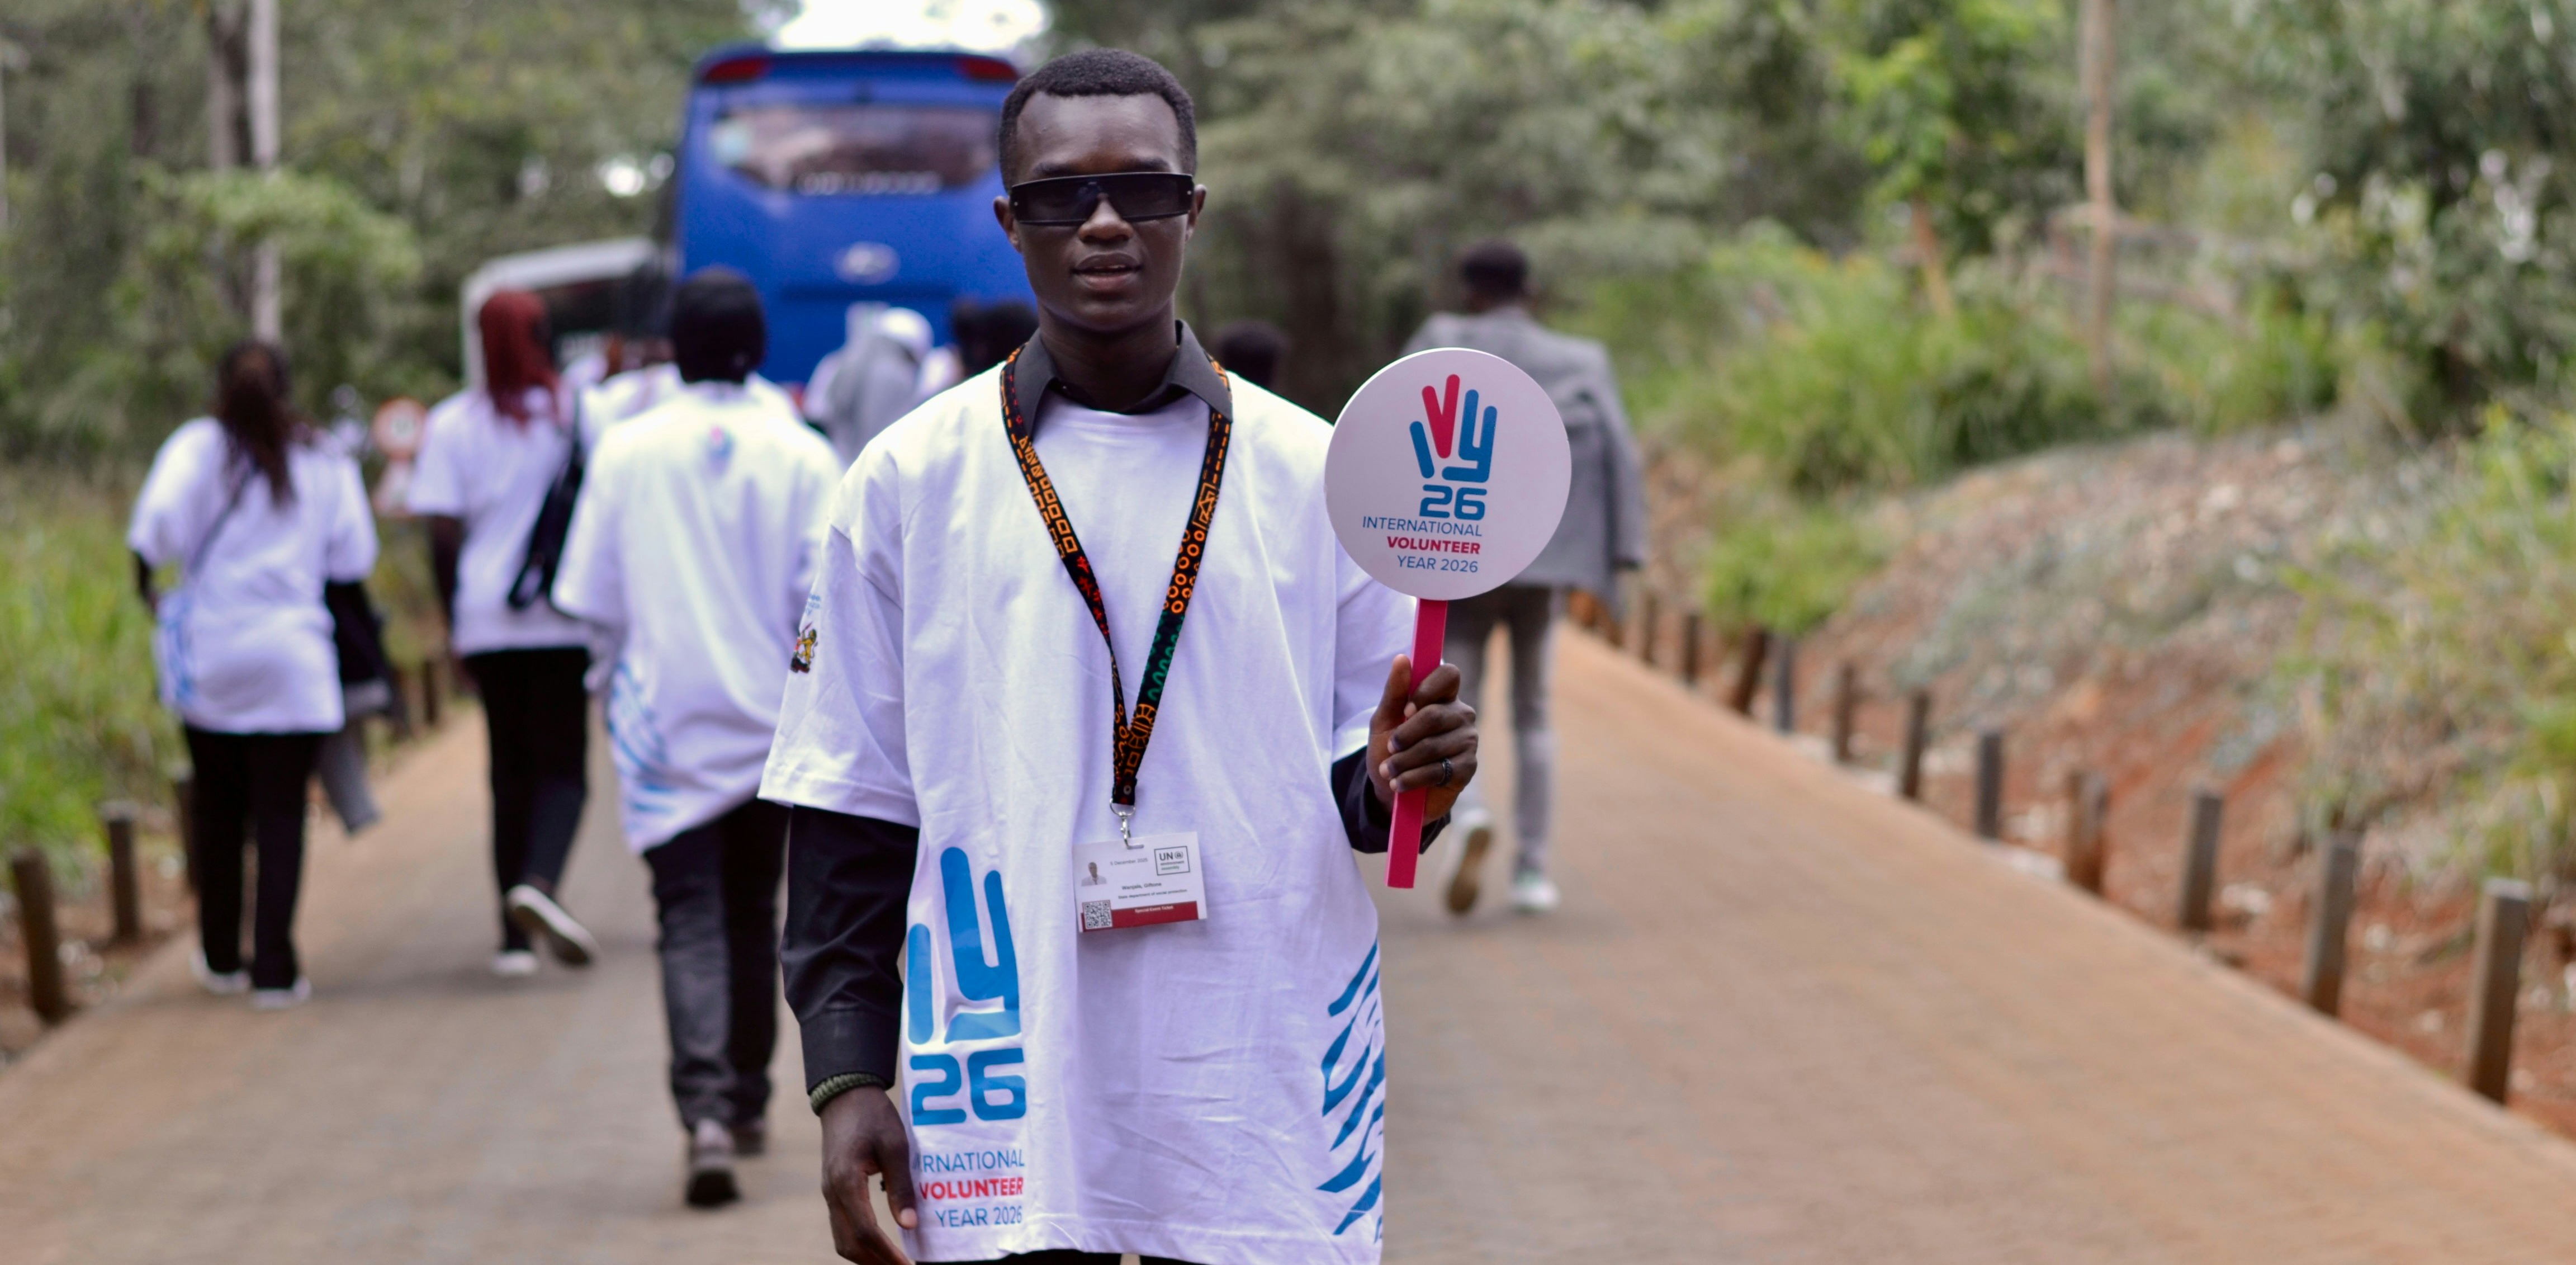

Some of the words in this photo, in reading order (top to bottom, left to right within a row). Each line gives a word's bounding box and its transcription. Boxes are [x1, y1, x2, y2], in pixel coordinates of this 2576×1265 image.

[1419, 484, 1487, 521] 26
[1362, 516, 1482, 536] INTERNATIONAL
[1387, 536, 1480, 554] VOLUNTEER
[1398, 555, 1436, 570] YEAR
[1441, 559, 1478, 573] 2026
[1159, 852, 1173, 861] UN
[910, 1047, 1026, 1126] 26
[912, 1149, 1025, 1172] RNATIONAL
[920, 1177, 1024, 1200] VOLUNTEER
[935, 1208, 988, 1227] YEAR
[993, 1206, 1022, 1225] 2026
